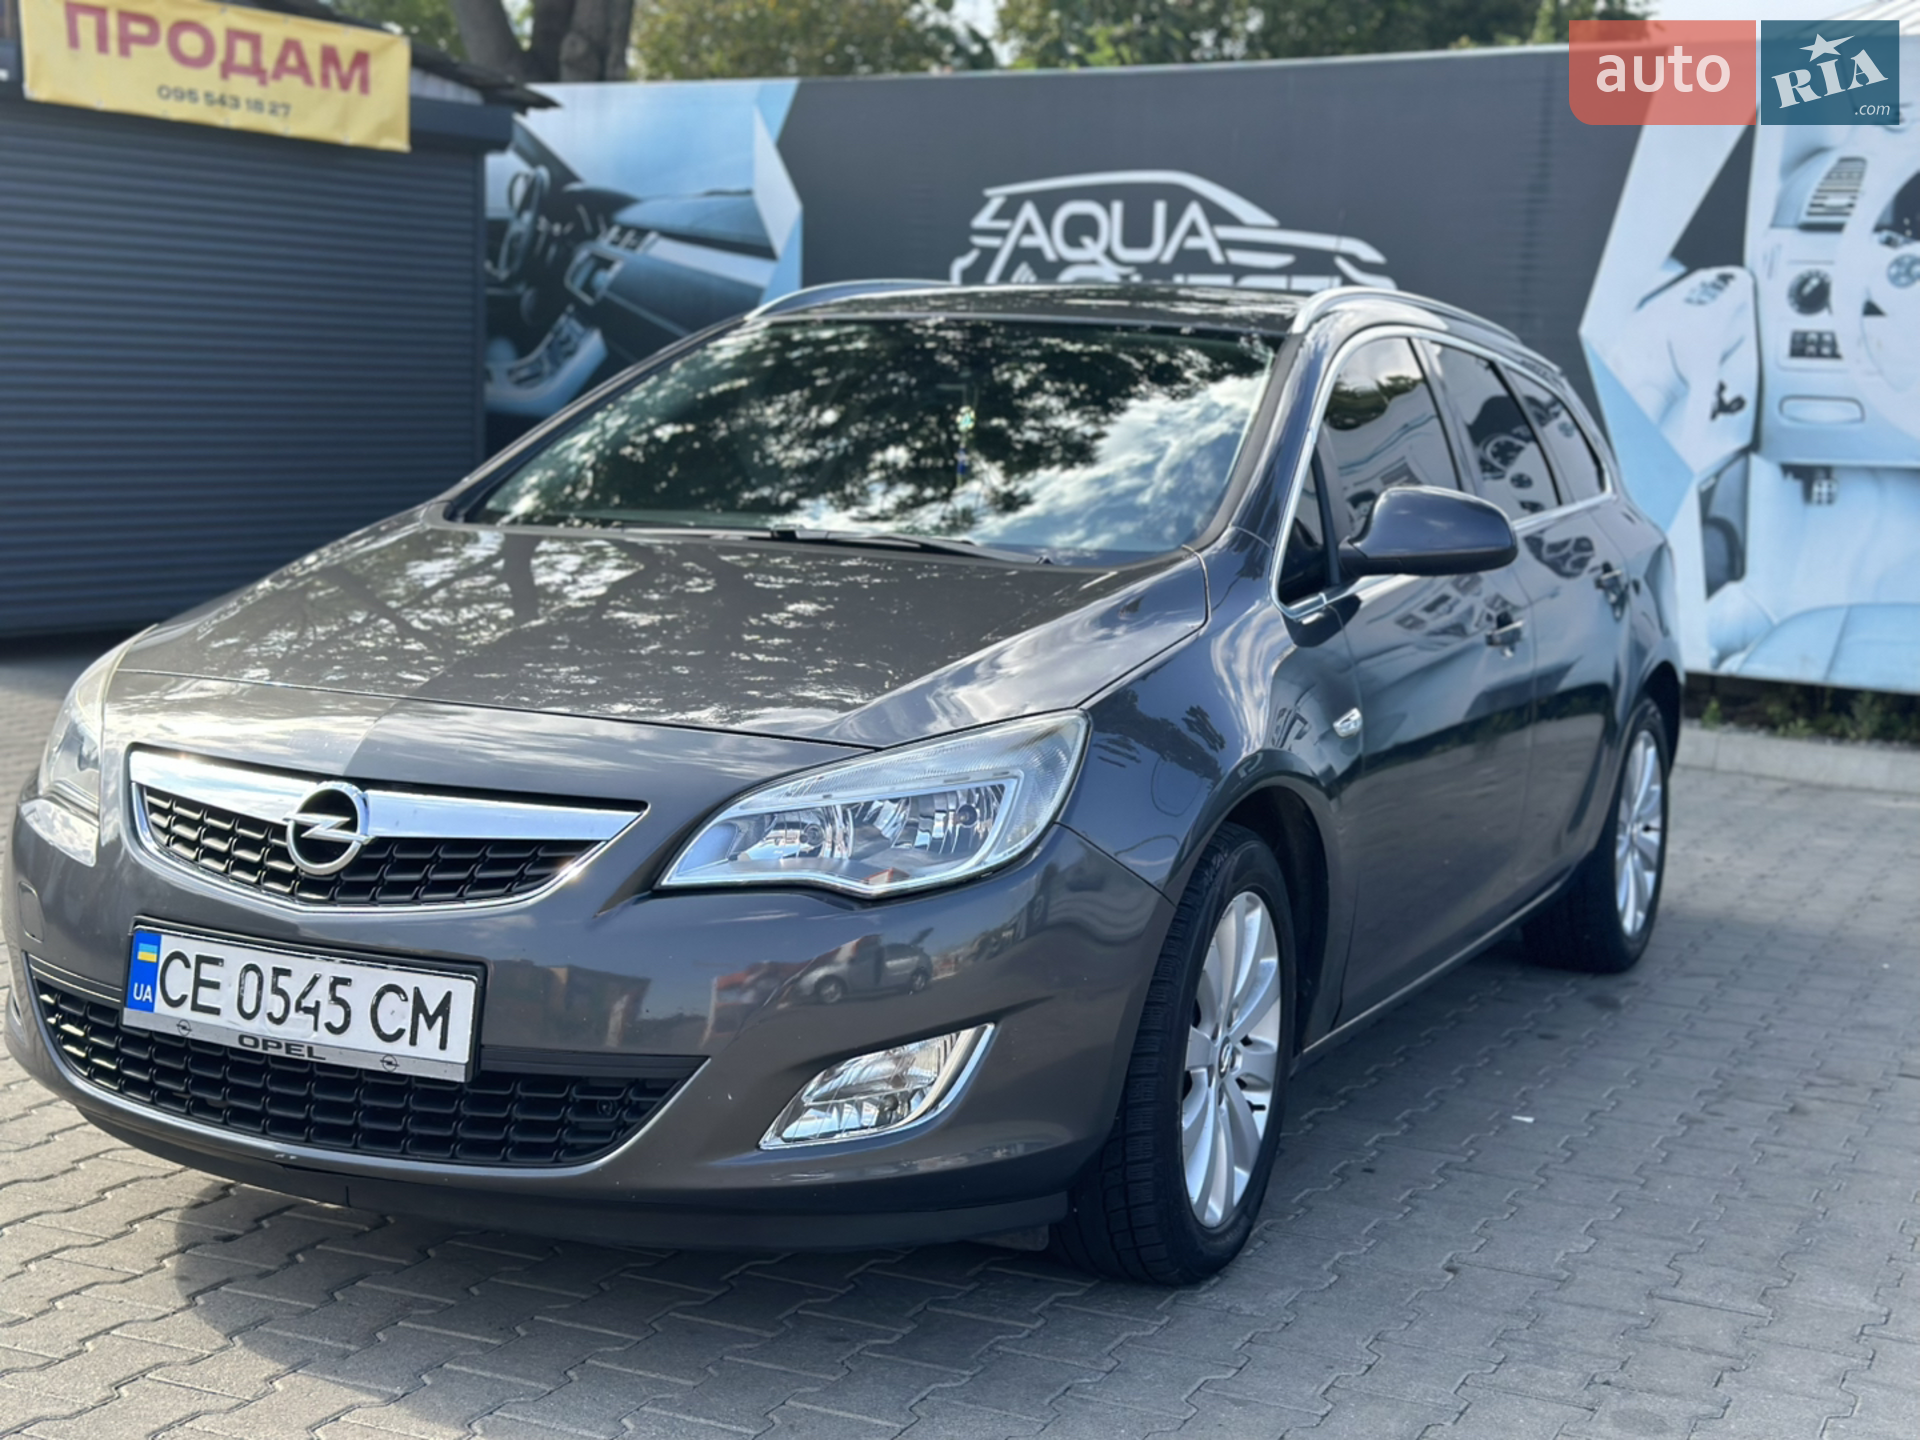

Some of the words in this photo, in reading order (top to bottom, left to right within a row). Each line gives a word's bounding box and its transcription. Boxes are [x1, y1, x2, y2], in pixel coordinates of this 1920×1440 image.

[65, 1, 371, 95] ПРОДАМ
[157, 85, 198, 104] 095
[204, 90, 240, 111] 543
[268, 100, 292, 118] 27
[985, 200, 1226, 278] AQUA
[133, 982, 152, 1002] UA
[159, 950, 225, 1016] CE
[237, 963, 352, 1036] 0545
[370, 983, 453, 1051] CM
[238, 1035, 326, 1060] OPEL
